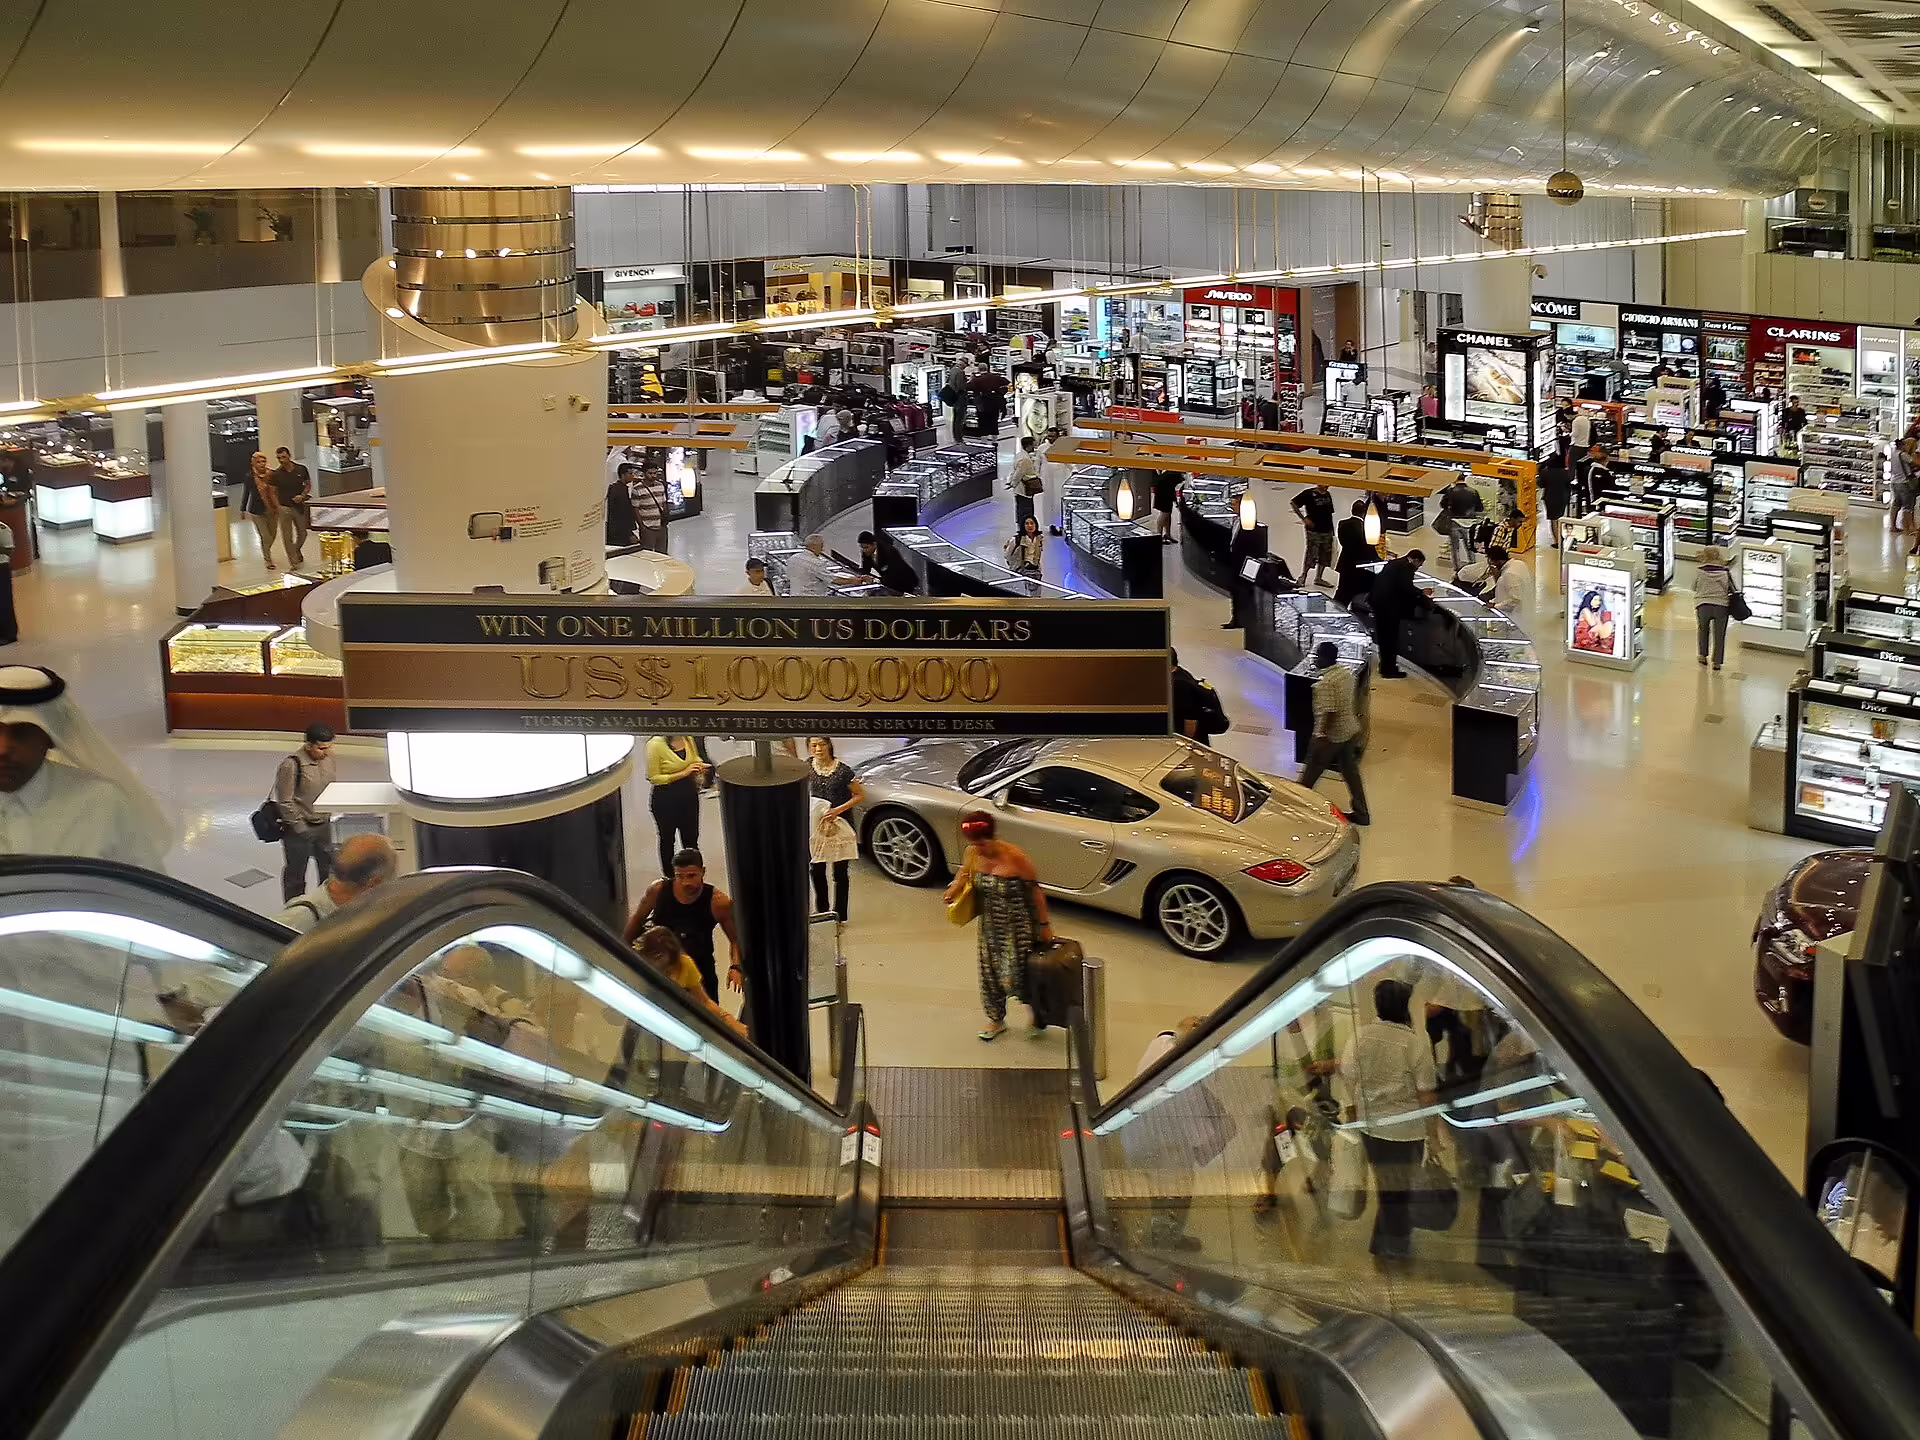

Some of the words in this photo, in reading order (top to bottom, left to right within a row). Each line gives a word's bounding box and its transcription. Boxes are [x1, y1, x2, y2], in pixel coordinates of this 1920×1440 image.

[614, 268, 655, 278] GIVENCHY
[1204, 289, 1252, 301] SHISEIDO
[1621, 312, 1660, 325] GIORGIO
[1660, 316, 1698, 329] ARMANI
[1456, 333, 1512, 347] CHANEL
[1767, 327, 1841, 342] CLARINS
[505, 505, 540, 513] GIVENCHY
[1584, 557, 1616, 569] KENZO
[1895, 606, 1919, 617] Dior
[476, 614, 547, 638] WIN
[557, 614, 633, 638] ONE
[641, 615, 800, 640] MILLION
[808, 617, 854, 640] US
[864, 618, 1032, 642] DOLLARS
[1879, 651, 1906, 663] Dior
[1861, 701, 1888, 713] Dior
[520, 715, 595, 728] TICKETS
[600, 716, 699, 729] AVAILABLE
[705, 717, 729, 729] AT
[732, 717, 768, 729] THE
[774, 718, 869, 730] CUSTOMER
[873, 718, 947, 731] SERVICE
[953, 719, 996, 731] DESK
